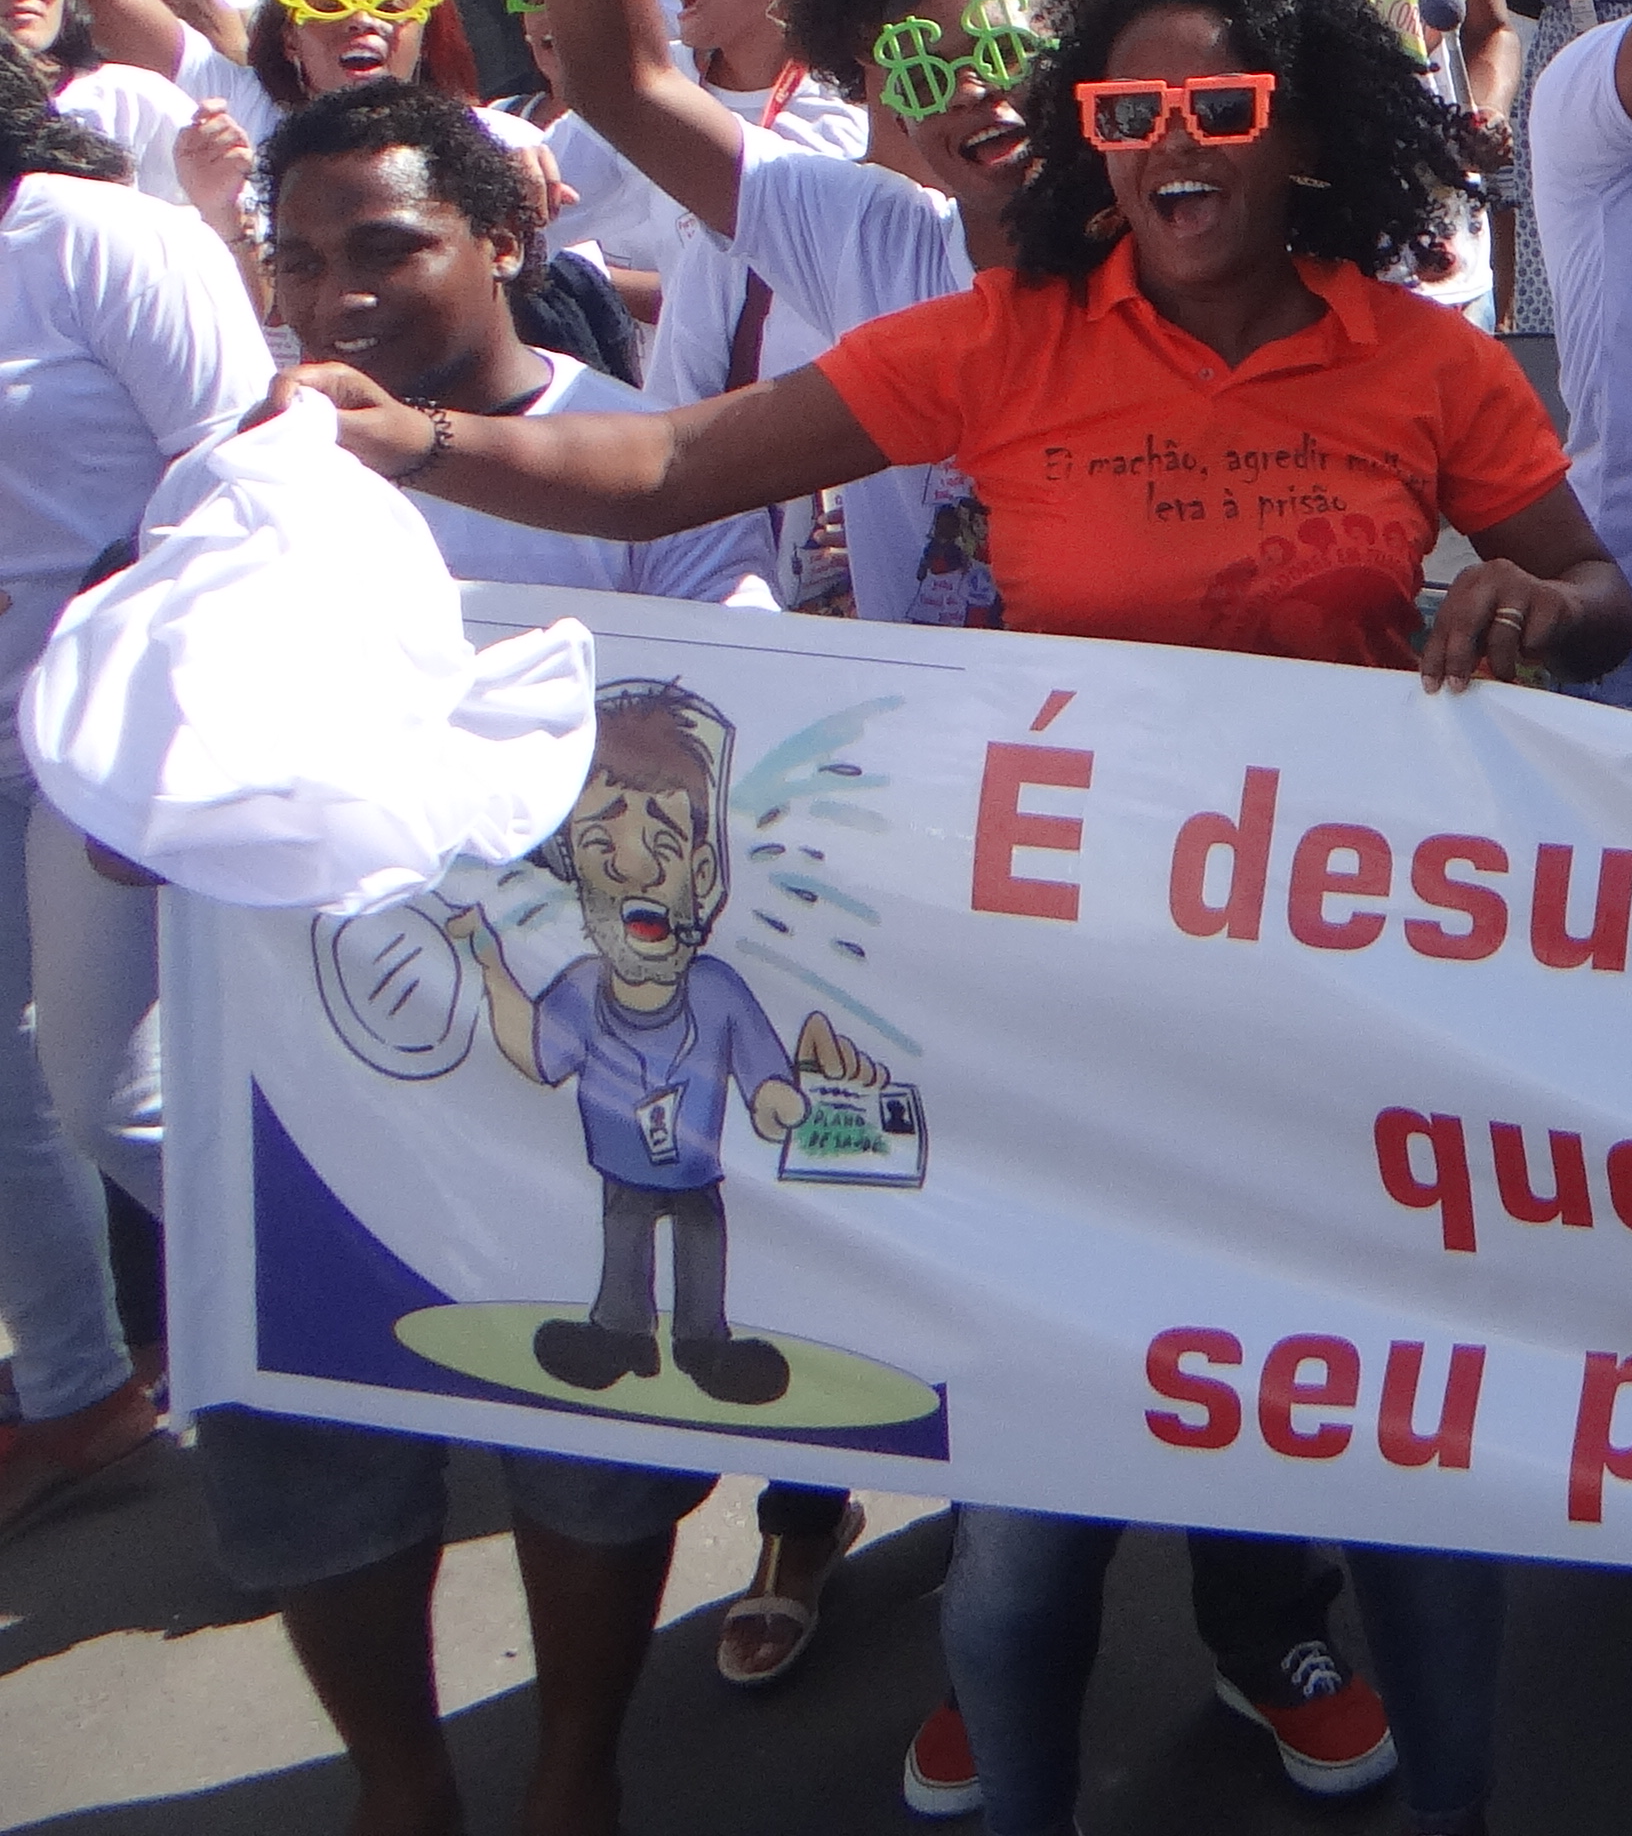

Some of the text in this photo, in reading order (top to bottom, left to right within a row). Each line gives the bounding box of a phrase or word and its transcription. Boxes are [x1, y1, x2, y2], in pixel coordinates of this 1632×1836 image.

[1225, 432, 1330, 485] agredir
[1258, 484, 1348, 530] prisão
[970, 690, 1095, 922] É
[1144, 1325, 1487, 1471] seu
